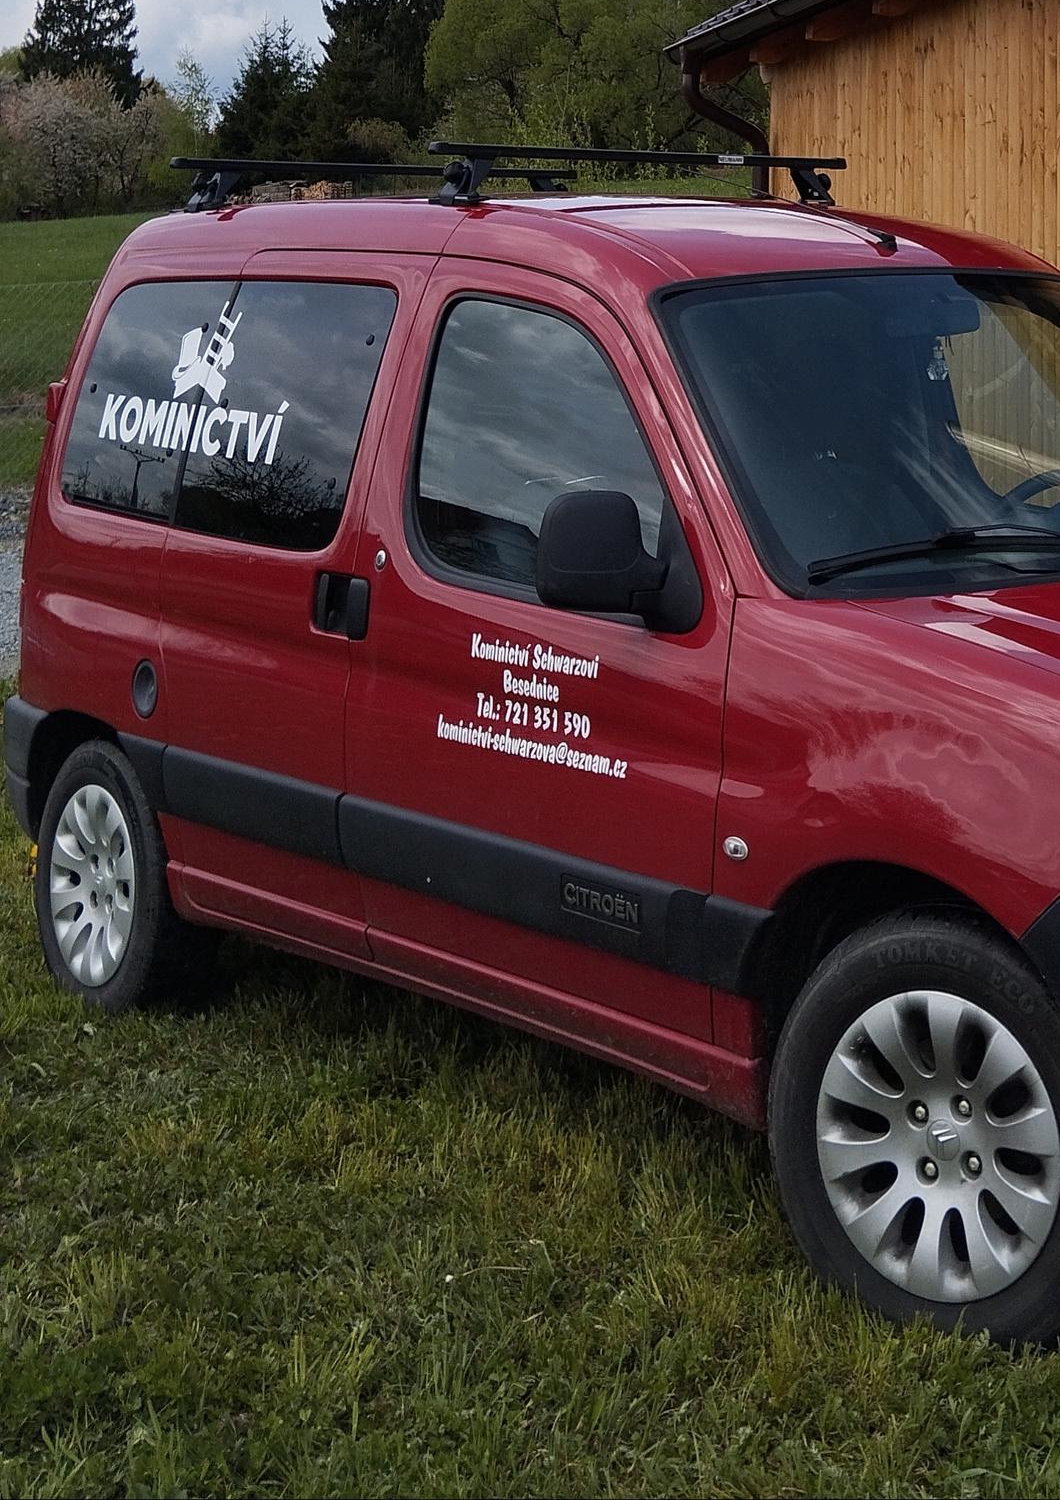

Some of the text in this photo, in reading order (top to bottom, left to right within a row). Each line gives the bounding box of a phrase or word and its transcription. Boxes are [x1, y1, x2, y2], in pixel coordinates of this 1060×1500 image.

[98, 393, 290, 465] KOMINICTVÍ
[471, 632, 600, 679] Kominictví Schwarzovi
[503, 669, 560, 703] Besednice
[476, 692, 591, 739] Tel.: 721 351 590
[437, 713, 628, 779] kominictvi-schwarzova@seznam.cz
[564, 883, 639, 924] CITROËN
